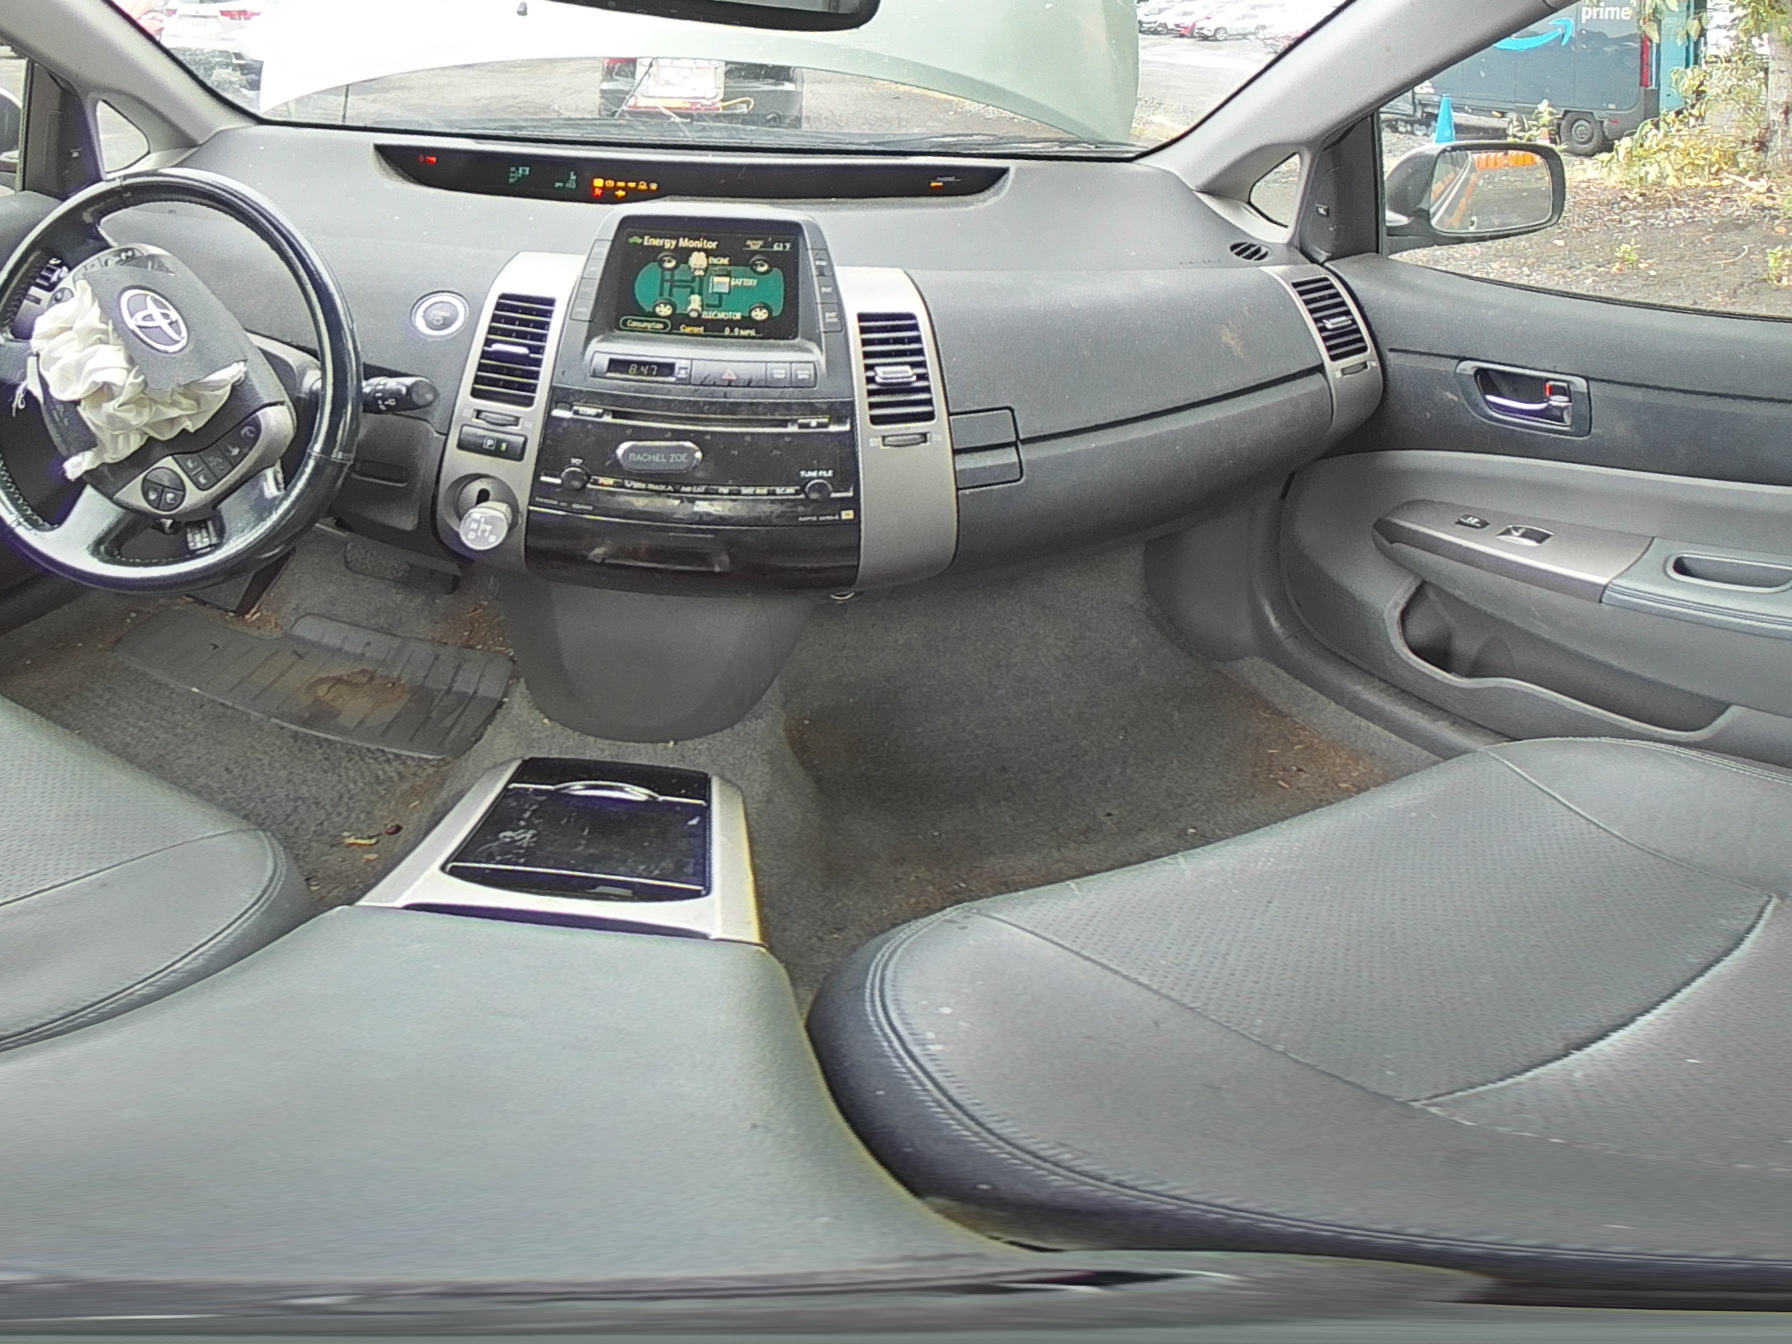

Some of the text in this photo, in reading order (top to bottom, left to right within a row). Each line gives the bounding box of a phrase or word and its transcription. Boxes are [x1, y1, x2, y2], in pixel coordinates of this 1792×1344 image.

[1581, 1, 1632, 24] prime
[643, 236, 718, 249] Energy Monitor
[629, 453, 688, 463] RACHEL ZOE
